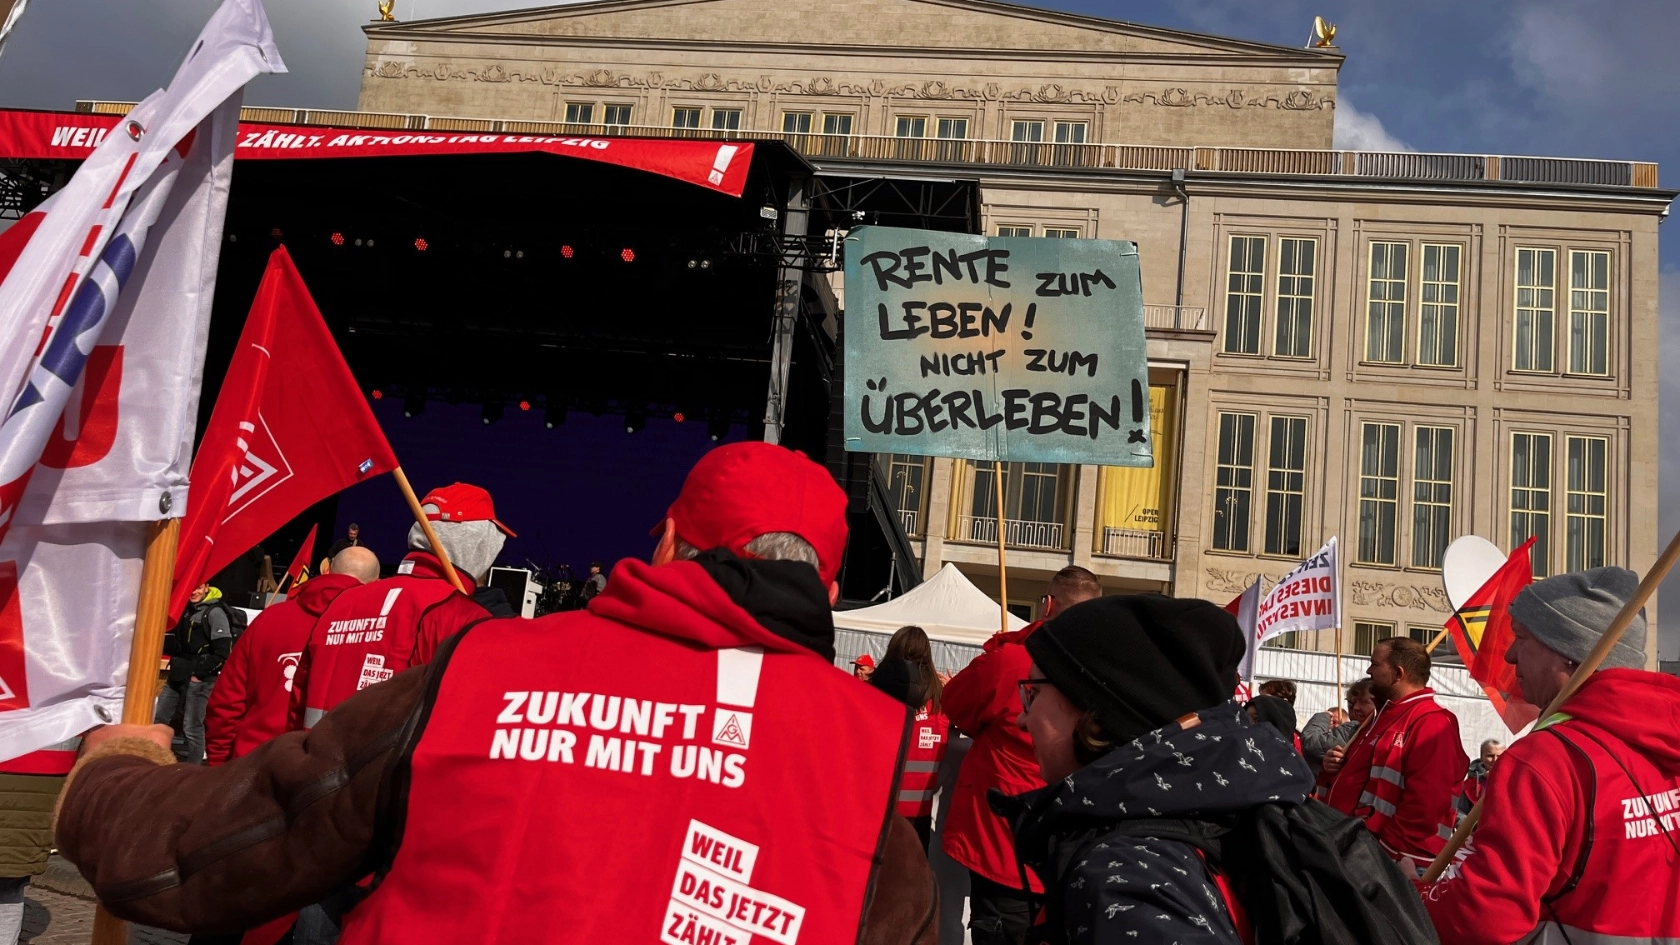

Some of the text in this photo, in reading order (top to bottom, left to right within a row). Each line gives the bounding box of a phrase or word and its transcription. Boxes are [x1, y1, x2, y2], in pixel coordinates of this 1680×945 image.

[50, 126, 107, 148] WEIL
[860, 246, 1116, 297] RENTE ZUM
[878, 301, 1037, 340] LEBEN!
[920, 349, 1098, 377] NICHT ZUM
[860, 376, 1147, 443] ÜBERLEBEN!
[1134, 514, 1158, 522] LEIPZIG
[327, 617, 377, 633] ZUKUNFT
[345, 631, 365, 644] MIT
[364, 630, 384, 643] UNS
[363, 669, 376, 678] DAS
[367, 656, 381, 666] WEIL
[496, 691, 706, 739] ZUKUNFT
[489, 728, 747, 788] NUR MIT UNS
[1621, 788, 1680, 819] ZUKUNF
[1625, 818, 1659, 839] NUR
[691, 830, 744, 874] WEIL
[679, 870, 796, 936] DAS JETZT
